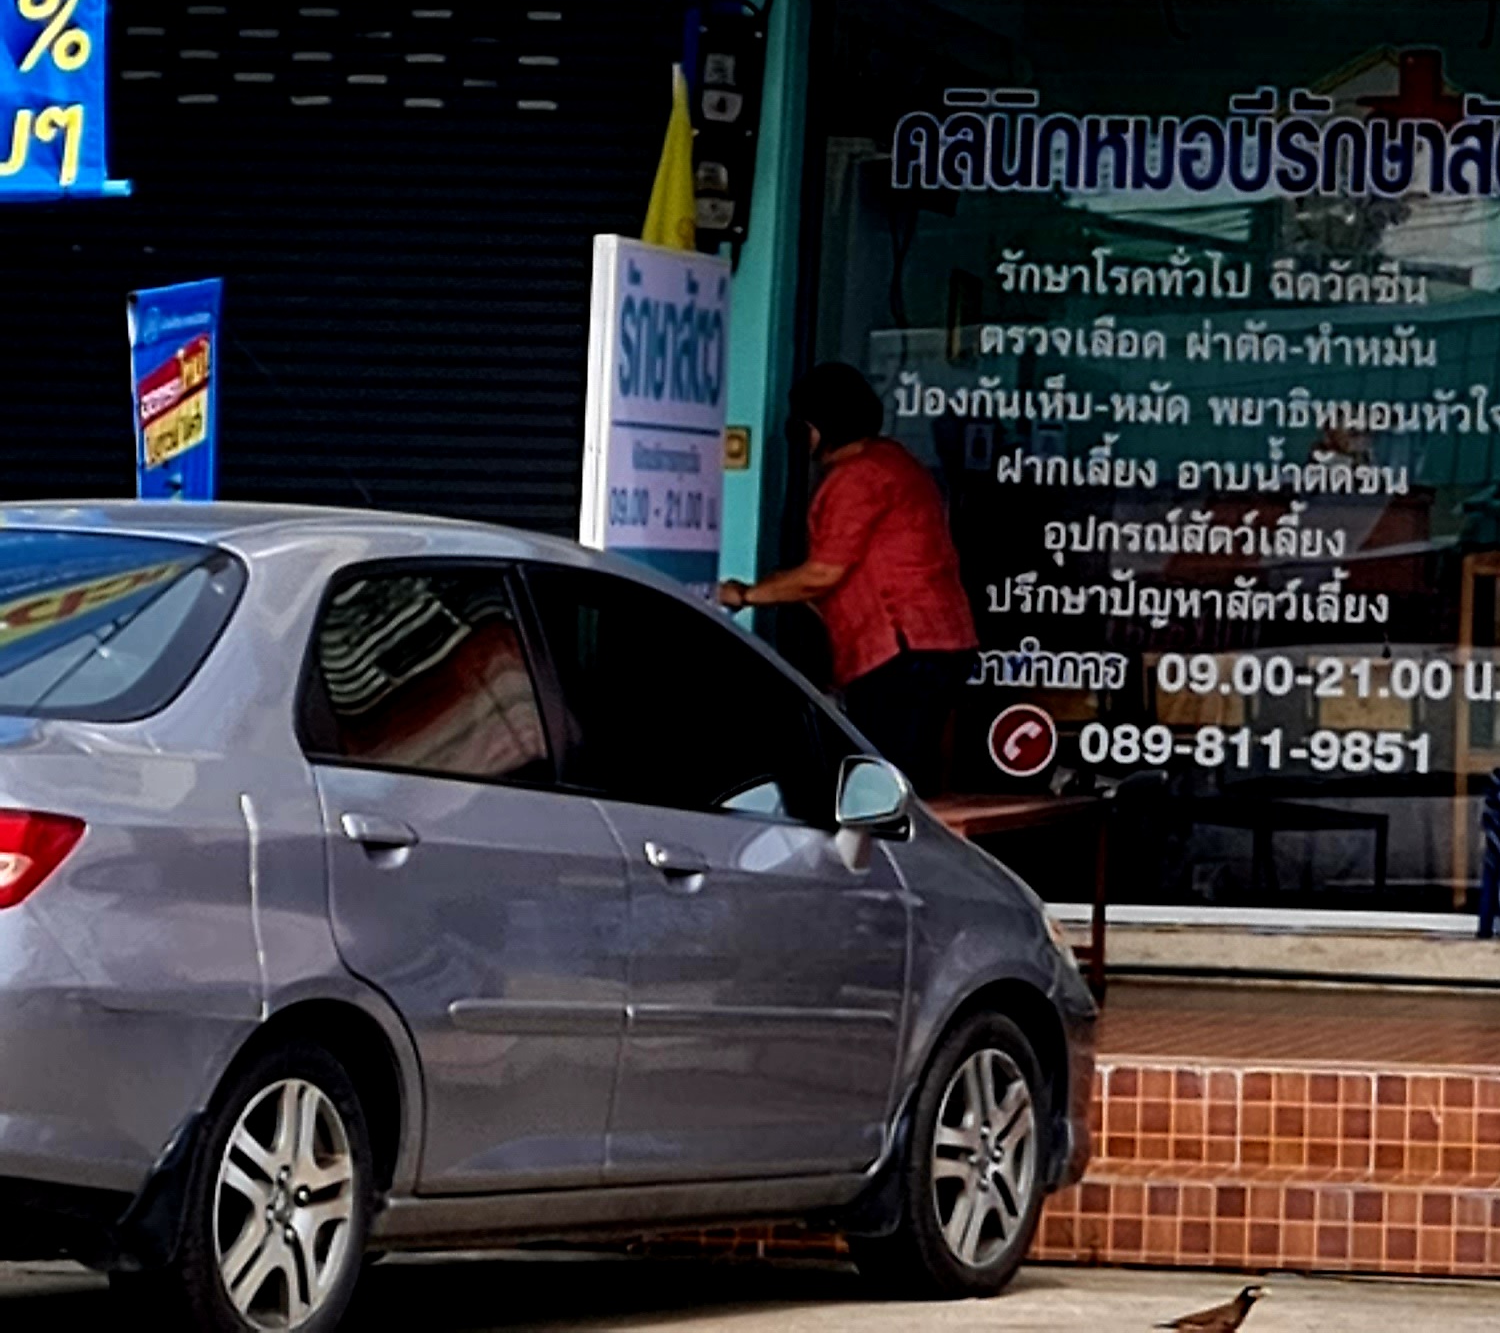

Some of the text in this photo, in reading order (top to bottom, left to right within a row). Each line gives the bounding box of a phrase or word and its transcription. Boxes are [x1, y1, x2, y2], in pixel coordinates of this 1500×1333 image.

[997, 245, 1428, 305] รักษาโรคทั่วไป ฉีดวัคซีน
[617, 257, 727, 407] รักษาสัตว์
[979, 313, 1167, 361] ตรวจเลือด
[893, 369, 1190, 423] ป้องกันเห็บ-หมัด
[996, 433, 1409, 497] ฝากเลี้ยง อาบน้ำตัดขน
[1043, 499, 1347, 568] อุปกรณ์สัตว์เลี้ยง
[985, 566, 1390, 629] ปรึกษาปัญหาสัตว์เลี้ยง
[1156, 652, 1452, 701] 09.00-21.00
[1079, 723, 1433, 774] 089-811-9851
